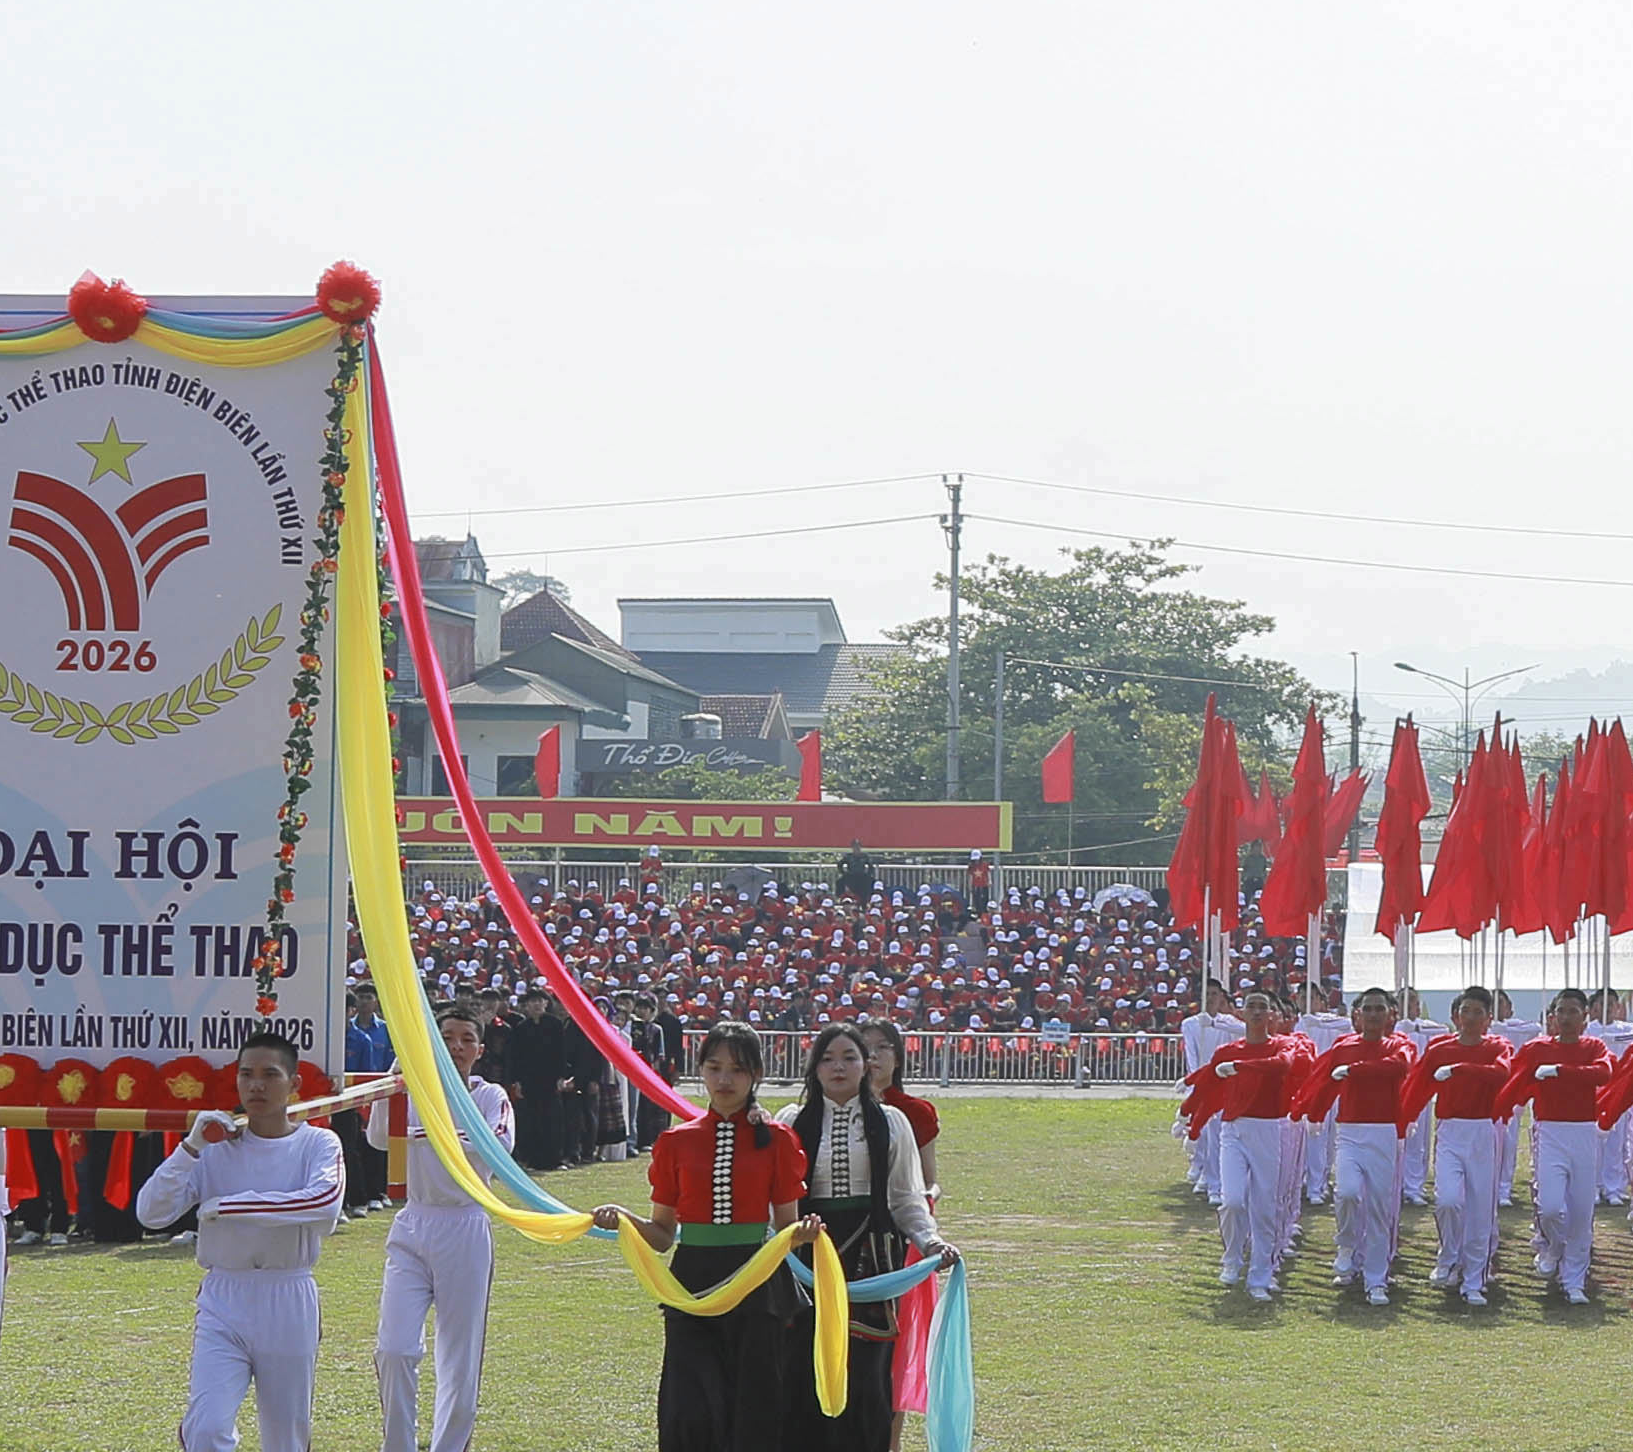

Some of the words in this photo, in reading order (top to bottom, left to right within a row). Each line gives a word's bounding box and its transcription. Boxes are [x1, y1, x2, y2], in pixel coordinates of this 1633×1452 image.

[5, 369, 49, 413] THỂ
[48, 362, 107, 394] THAO
[111, 356, 163, 391] TỈNH
[163, 371, 215, 412] ĐIỆN
[213, 398, 262, 448] BIÊN
[271, 486, 305, 531] THỨ
[280, 535, 304, 566] XII
[56, 639, 158, 672] 2026
[573, 810, 793, 838] NĂM!
[114, 817, 240, 892] HỘI
[97, 902, 180, 976] THỂ
[2, 1006, 55, 1047] BIÊN
[60, 1004, 104, 1048] LẦN
[110, 1008, 156, 1049] THỨ
[158, 1017, 195, 1052] XII,
[202, 1010, 254, 1050] NĂM
